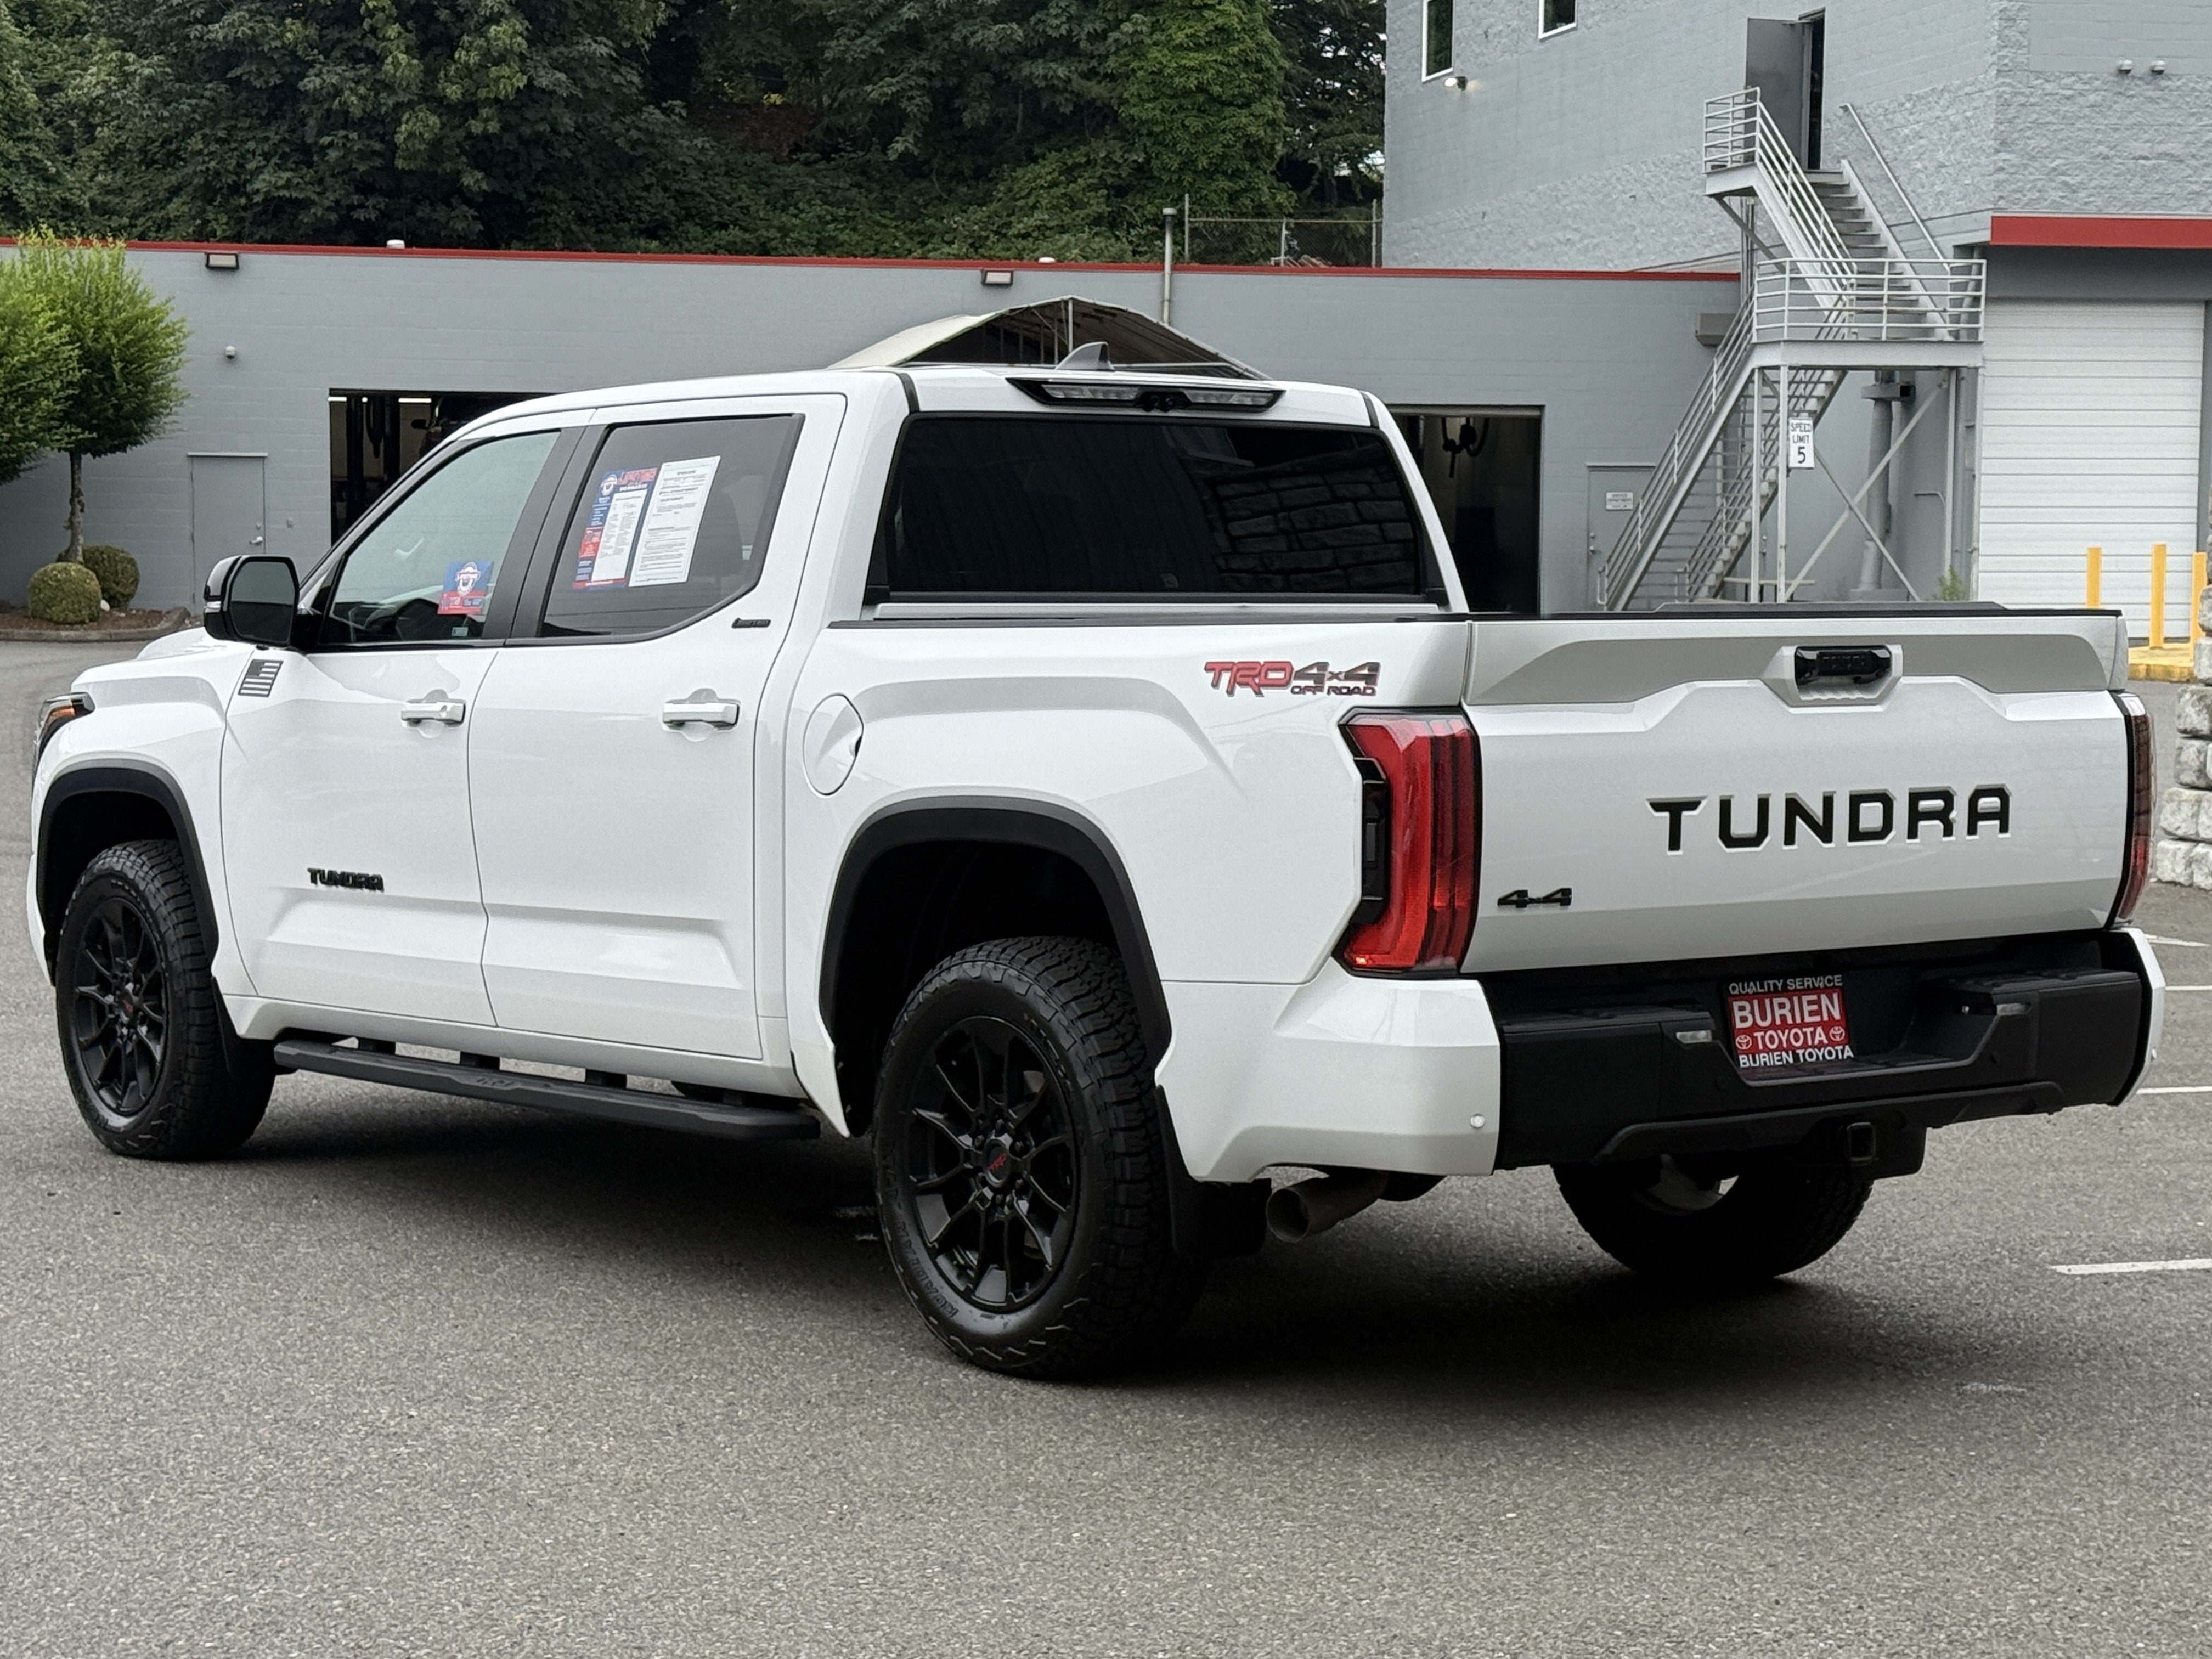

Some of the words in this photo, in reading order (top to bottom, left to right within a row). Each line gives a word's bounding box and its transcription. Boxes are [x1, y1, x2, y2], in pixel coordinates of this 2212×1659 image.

[1790, 422, 1812, 432] SPEED
[1792, 434, 1809, 444] LIMIT
[1797, 446, 1806, 464] 5
[1204, 661, 1295, 697] TRD
[1290, 685, 1325, 695] OFF
[1326, 685, 1377, 696] ROAD
[1646, 785, 2012, 854] TUNDRA
[307, 867, 384, 893] TUNDRA
[1729, 979, 1784, 995] QUALITY
[1786, 974, 1843, 990] SERVICE
[1732, 992, 1841, 1029] BURIEN
[1753, 1026, 1830, 1050] TOYOTA
[1738, 1052, 1794, 1068] BURIEN
[1795, 1045, 1854, 1063] TOYOTA
